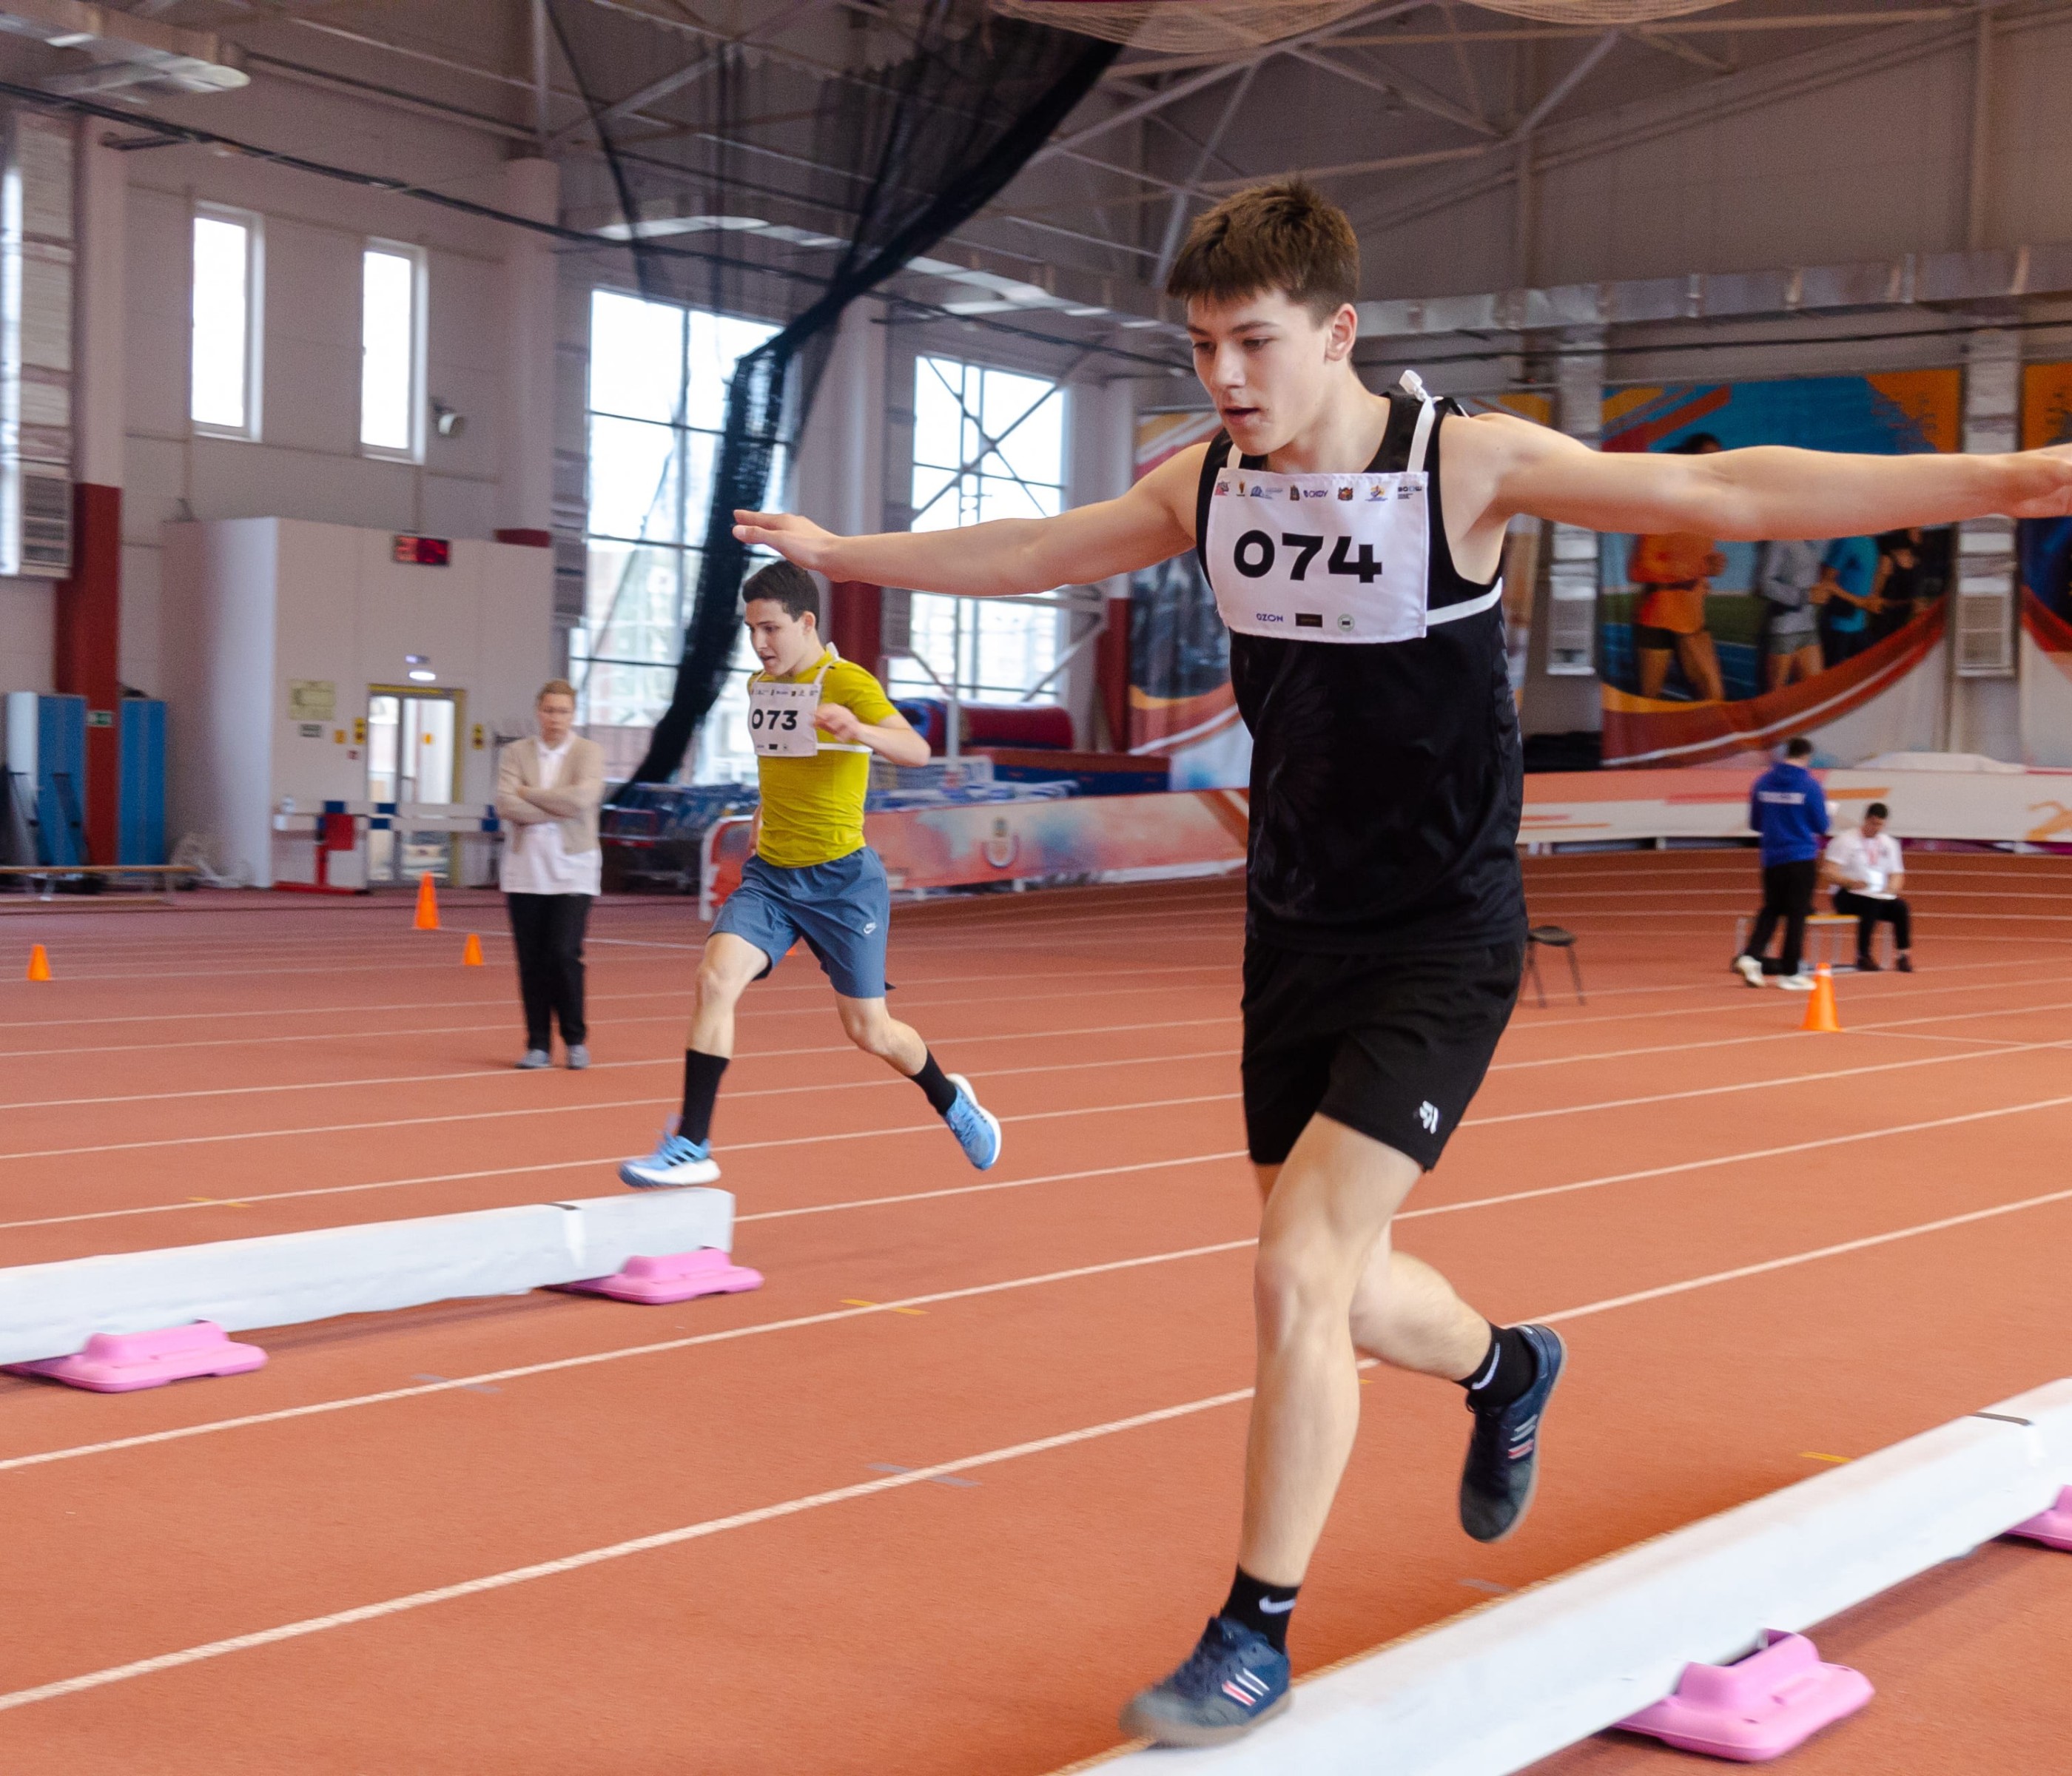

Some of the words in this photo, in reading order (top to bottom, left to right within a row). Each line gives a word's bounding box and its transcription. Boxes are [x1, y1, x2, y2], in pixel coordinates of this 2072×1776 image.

[1234, 529, 1382, 583] 074
[1256, 613, 1283, 622] OZON
[752, 708, 798, 730] 073
